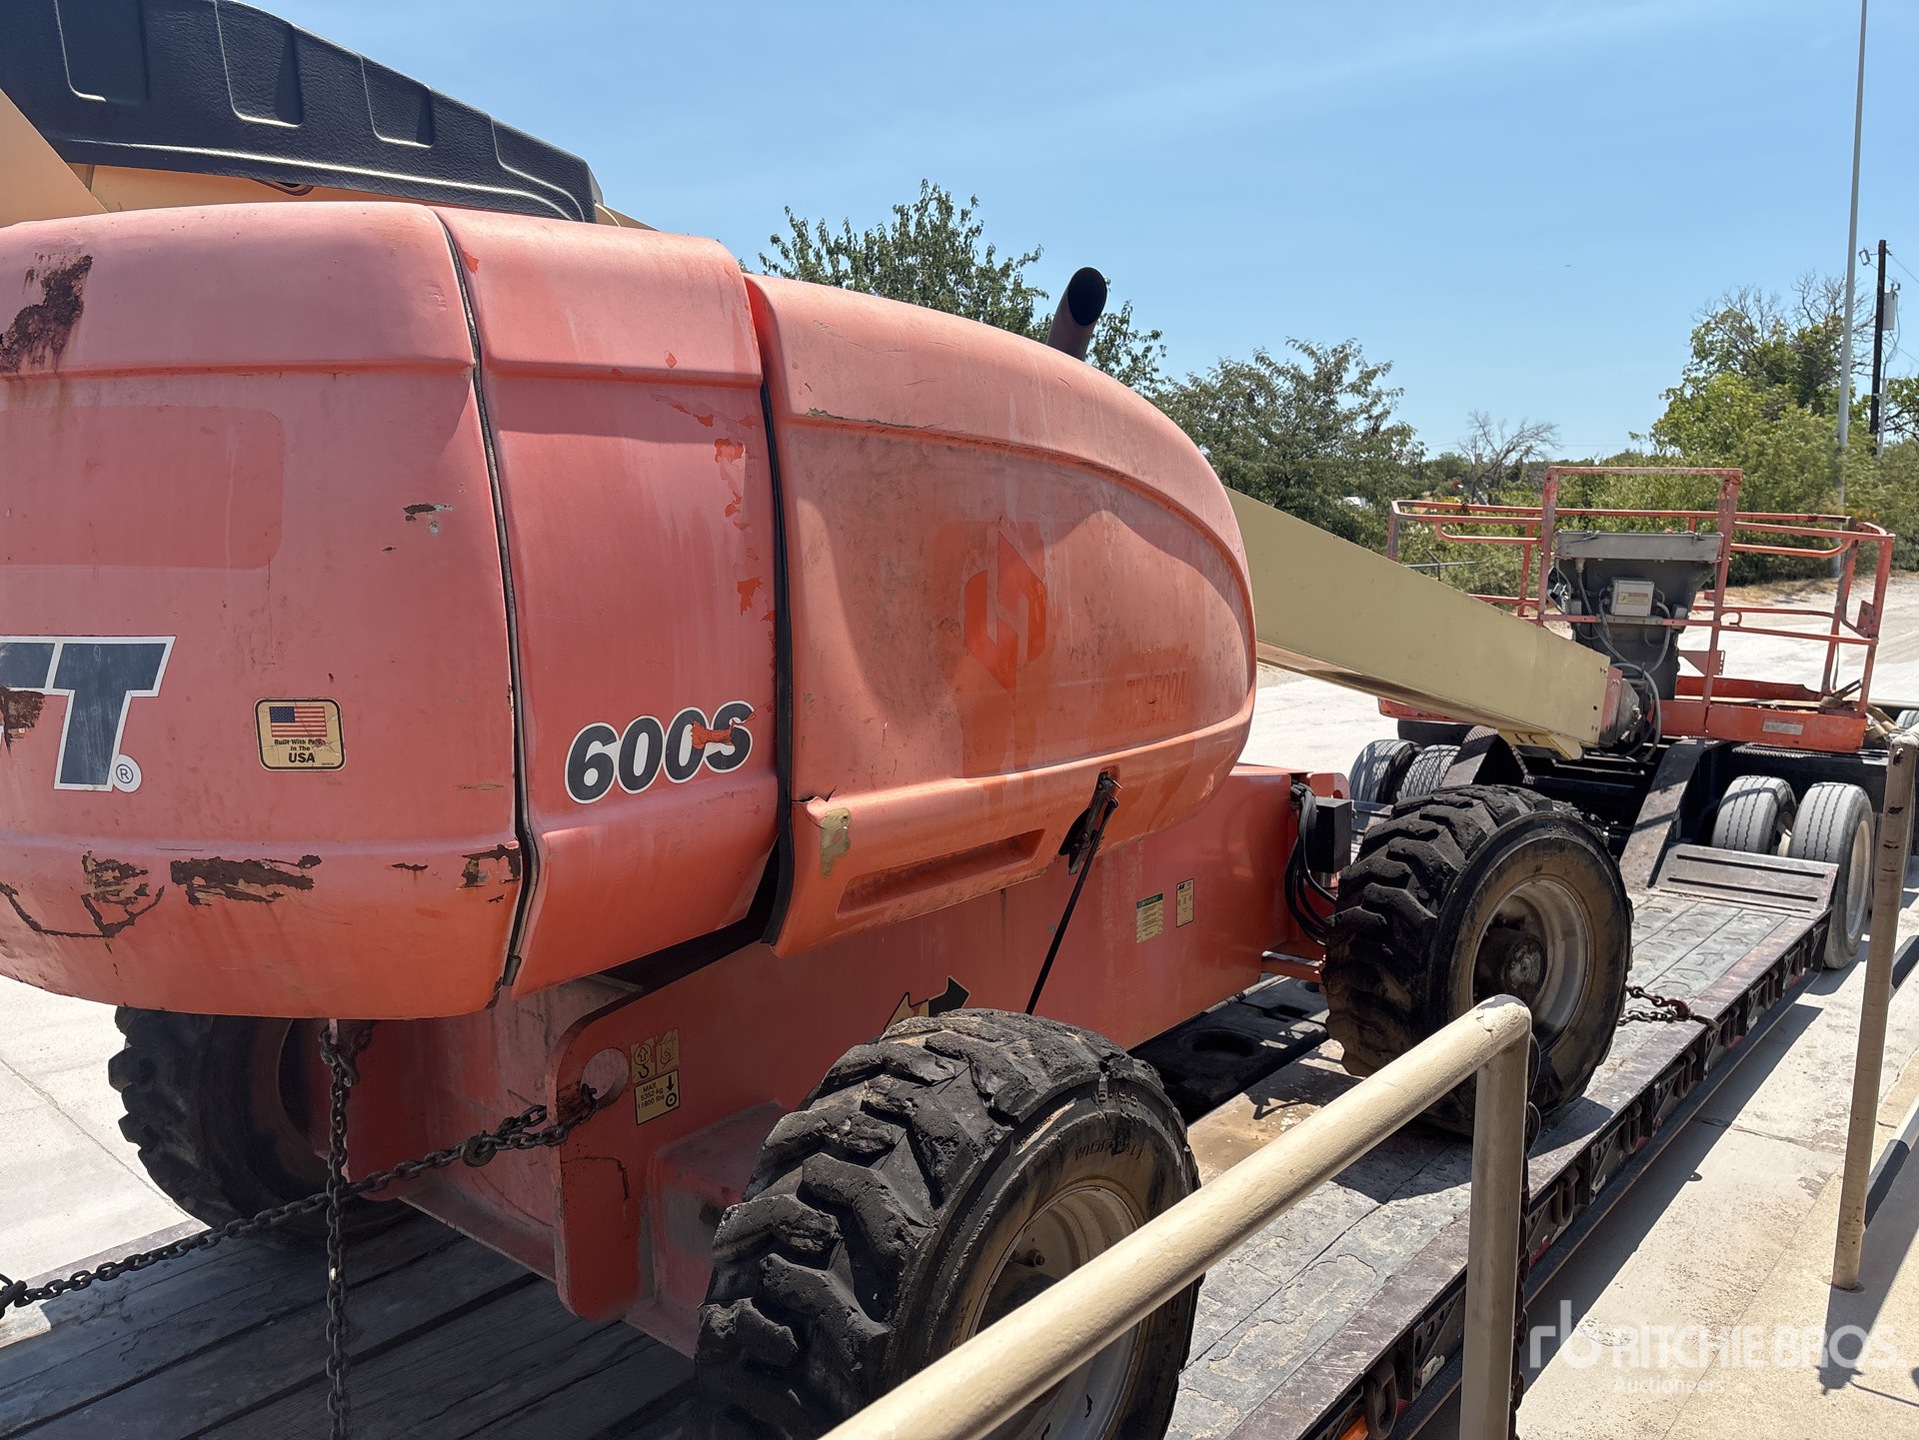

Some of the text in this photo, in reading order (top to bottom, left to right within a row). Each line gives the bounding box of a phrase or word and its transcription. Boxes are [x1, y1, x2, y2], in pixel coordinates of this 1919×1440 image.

[565, 700, 755, 804] 600S
[288, 753, 315, 763] USA
[643, 1082, 656, 1092] MAX
